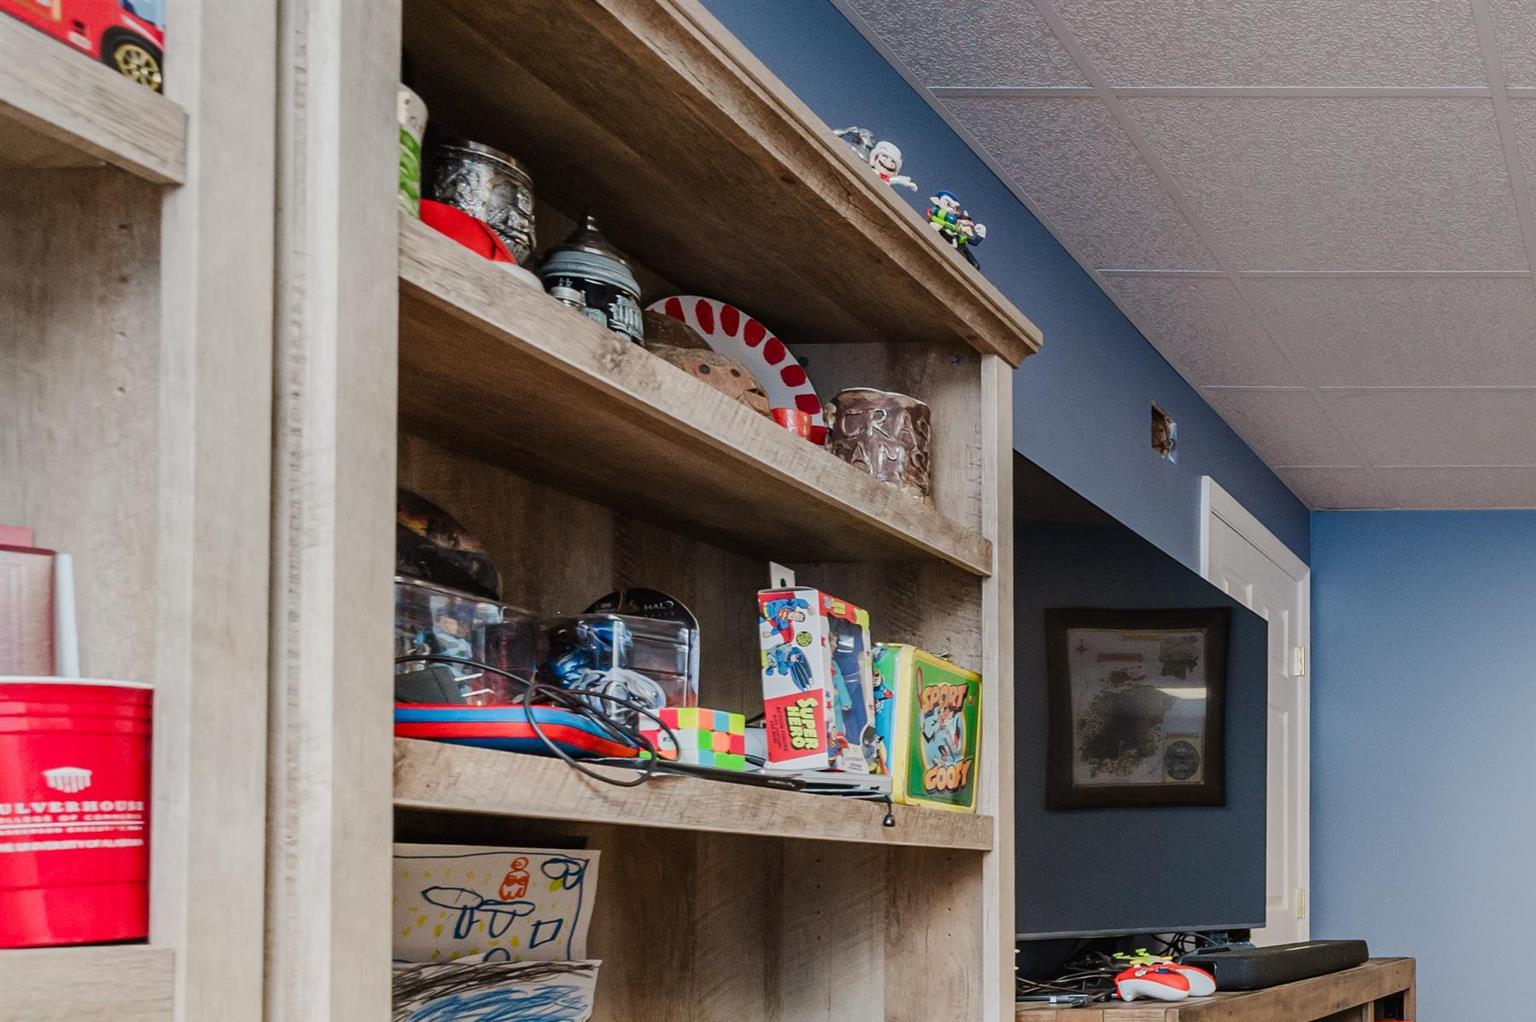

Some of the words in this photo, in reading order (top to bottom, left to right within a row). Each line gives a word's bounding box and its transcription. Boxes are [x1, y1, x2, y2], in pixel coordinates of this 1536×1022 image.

[922, 682, 969, 713] SPORT
[785, 705, 806, 749] HERO
[796, 697, 819, 750] SUPER
[923, 757, 973, 795] GOOFY
